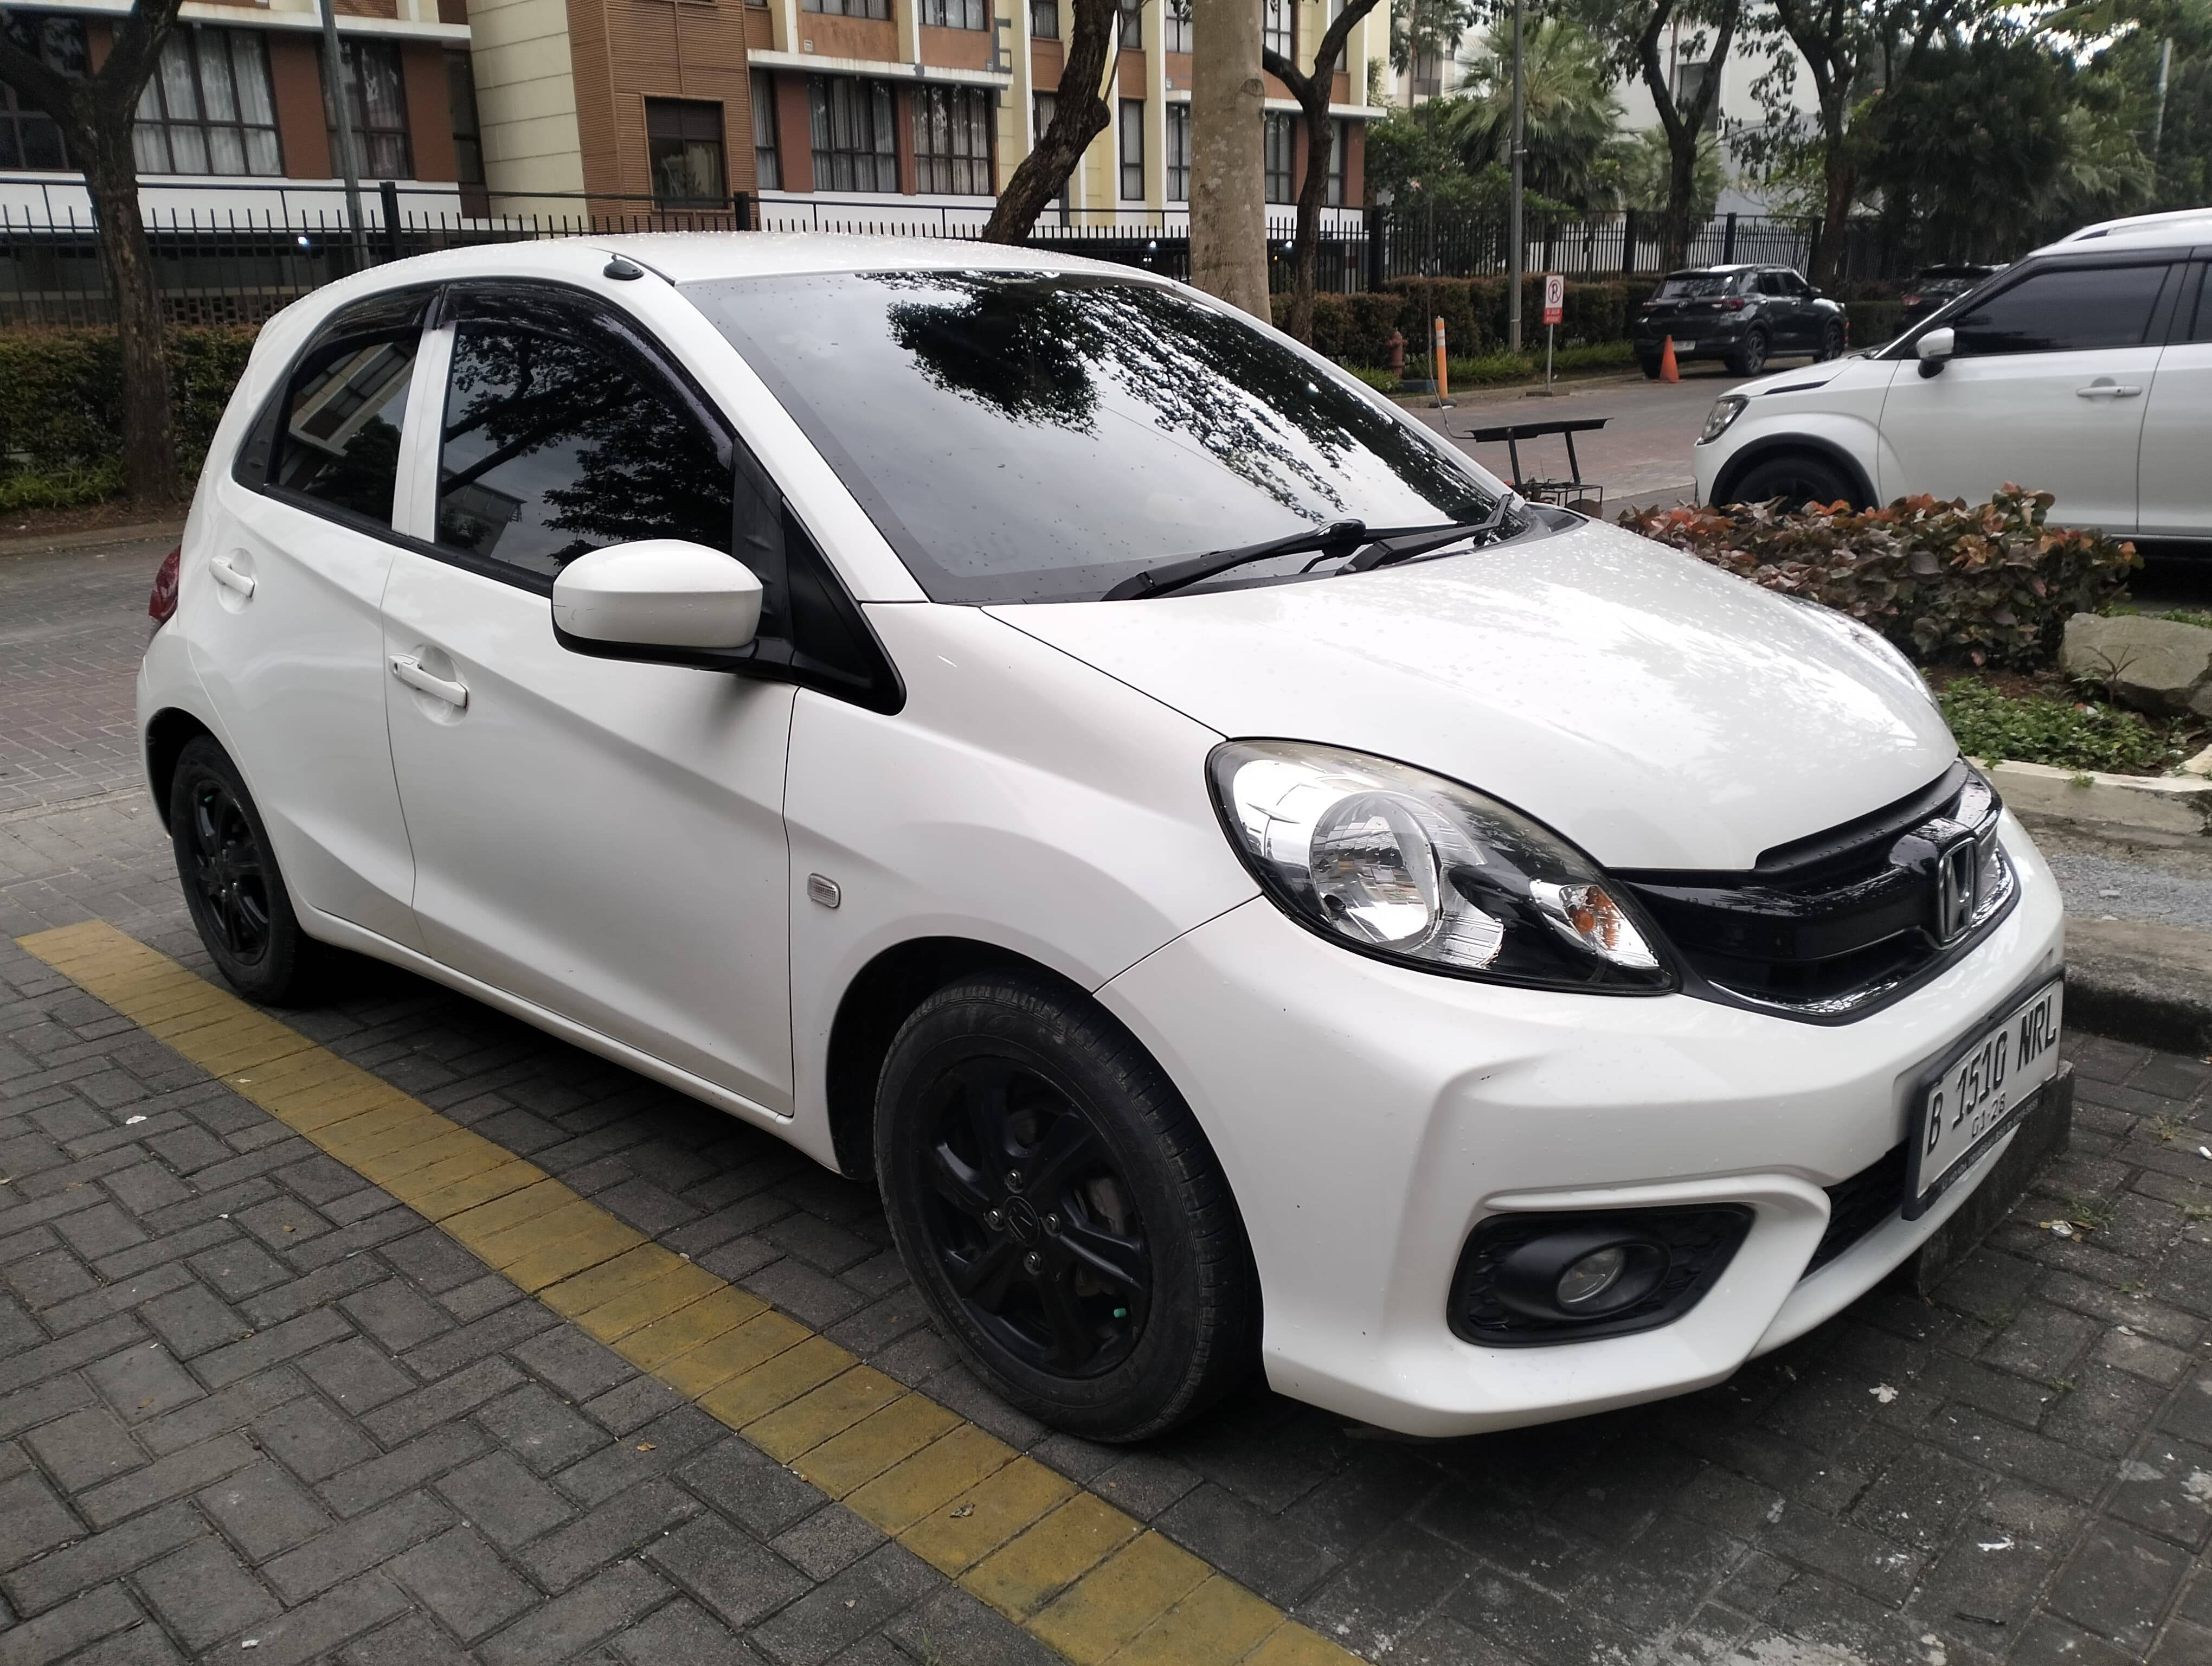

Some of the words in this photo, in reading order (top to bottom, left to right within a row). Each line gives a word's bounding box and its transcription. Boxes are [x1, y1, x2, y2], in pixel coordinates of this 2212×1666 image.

[1927, 1091, 1943, 1155] B
[1952, 1030, 2008, 1130] 1510
[2017, 994, 2056, 1072] NRL
